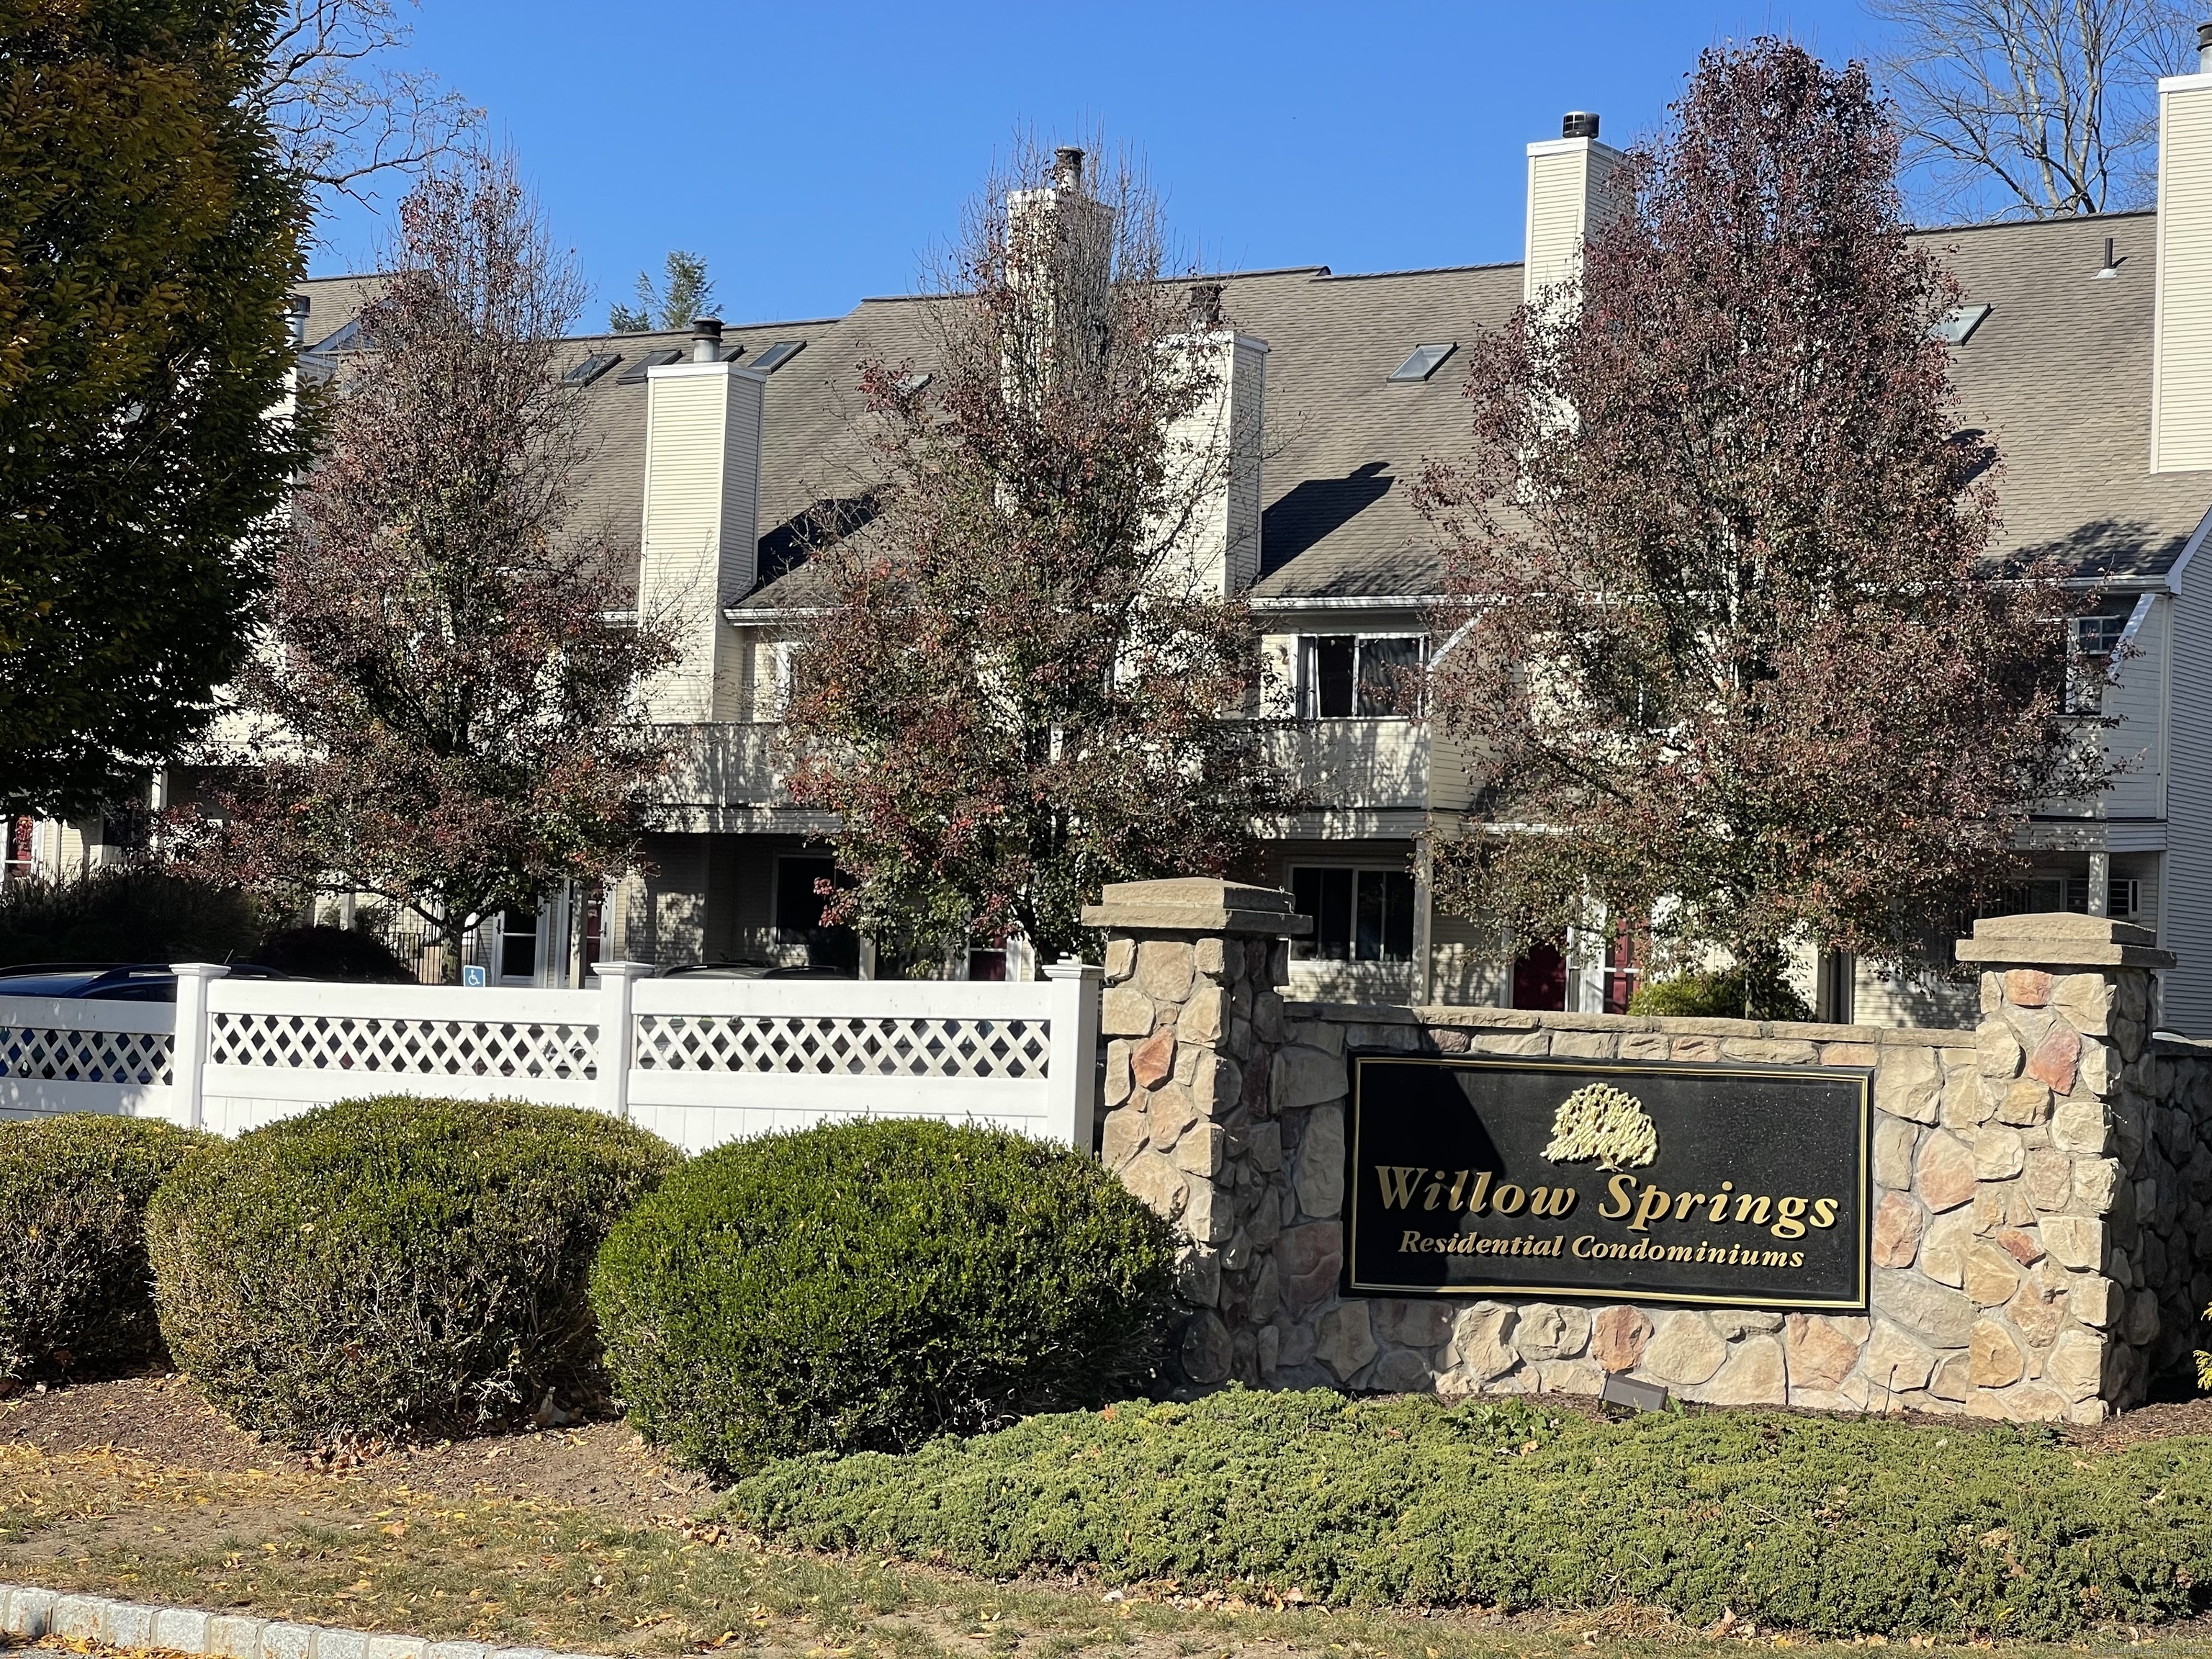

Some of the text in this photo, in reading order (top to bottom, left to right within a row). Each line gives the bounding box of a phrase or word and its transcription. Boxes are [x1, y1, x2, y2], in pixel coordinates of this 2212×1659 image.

[1375, 1165, 1839, 1238] Willow Springs
[1398, 1231, 1804, 1267] Residential Condominiums
